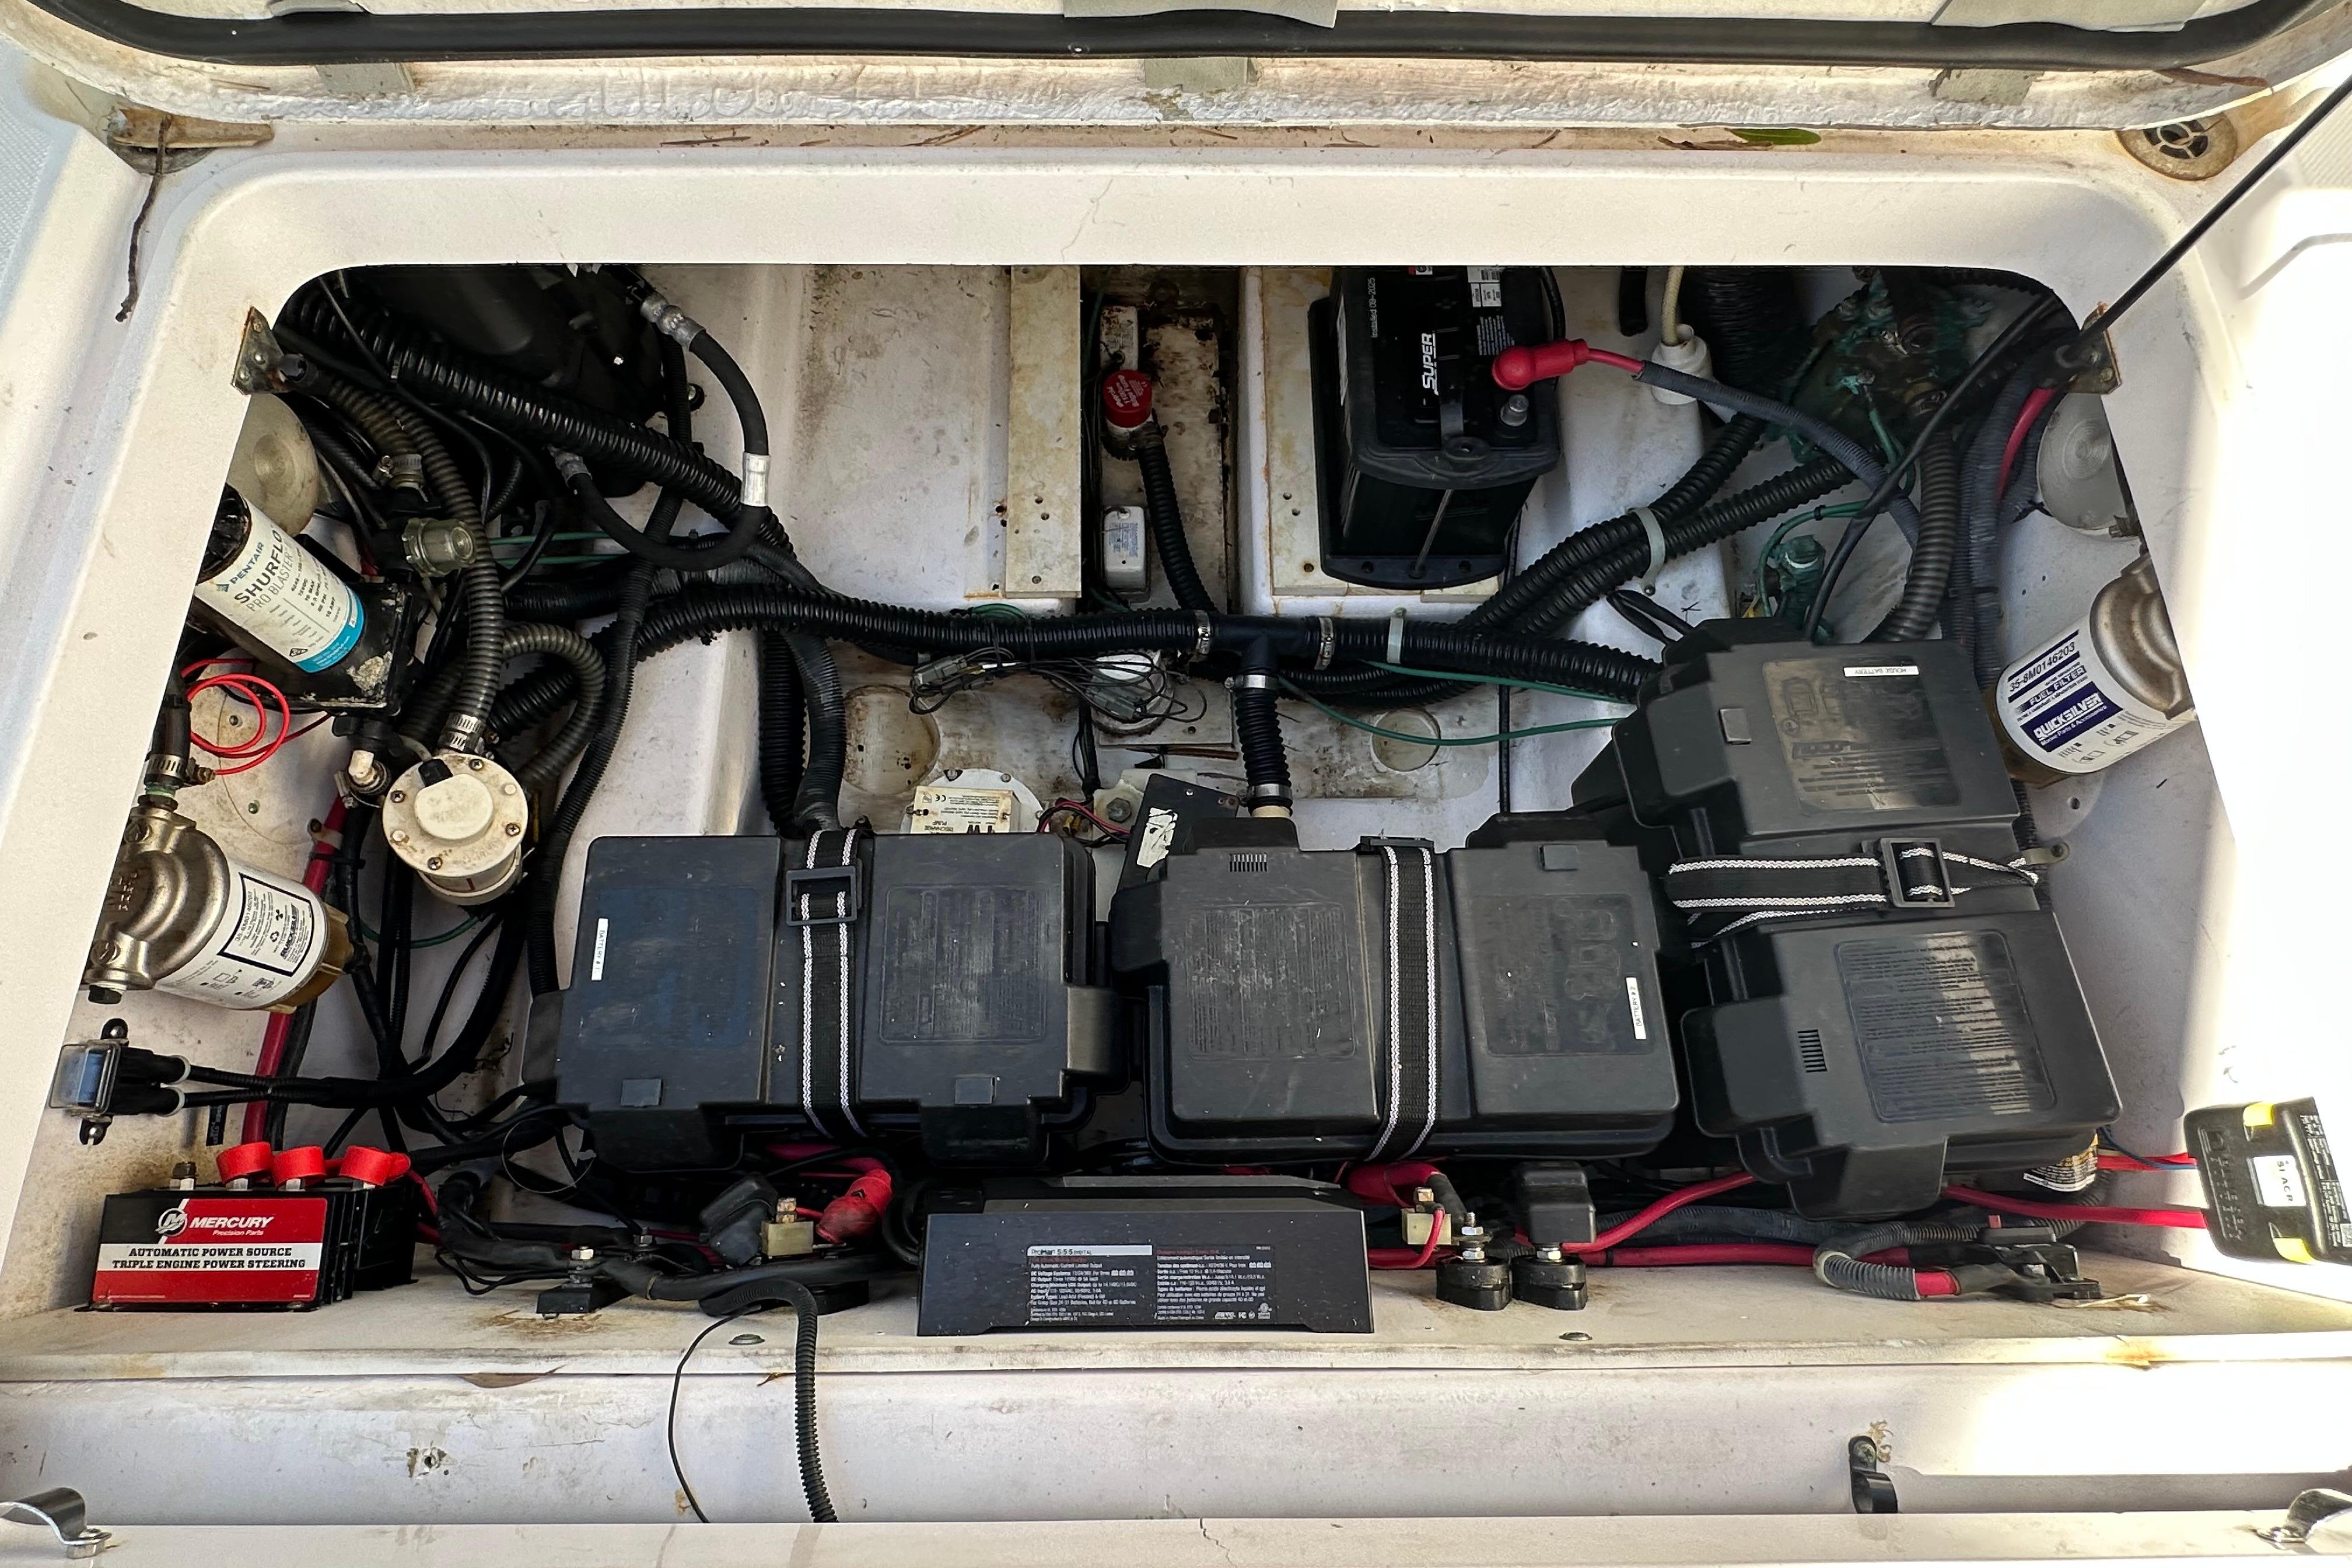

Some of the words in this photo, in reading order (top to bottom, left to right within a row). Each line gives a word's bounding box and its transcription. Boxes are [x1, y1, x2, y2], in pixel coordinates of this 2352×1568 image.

[1421, 332, 1435, 389] SUPER
[229, 541, 264, 584] PENTAIR
[235, 529, 282, 604] SHURFLO
[246, 593, 272, 612] PRO
[269, 554, 293, 596] BLASTER
[2010, 642, 2076, 692] 35-8M0146203
[2029, 687, 2053, 706] FUEL
[2053, 667, 2086, 690] FILTER
[2033, 692, 2102, 740] QUICKSILVER
[2057, 726, 2072, 736] Parts
[596, 930, 605, 958] BATTERY
[1632, 997, 1642, 1027] BATTERY
[2281, 1177, 2293, 1202] ACR
[190, 1216, 274, 1228] MERCURY
[112, 1260, 154, 1268] TRIPLE
[156, 1260, 200, 1268] ENGINE
[203, 1260, 245, 1268] POWER
[247, 1259, 306, 1268] STEERING
[129, 1248, 200, 1256] AUTOMATIC
[202, 1248, 244, 1256] POWER
[246, 1247, 292, 1256] SOURCE
